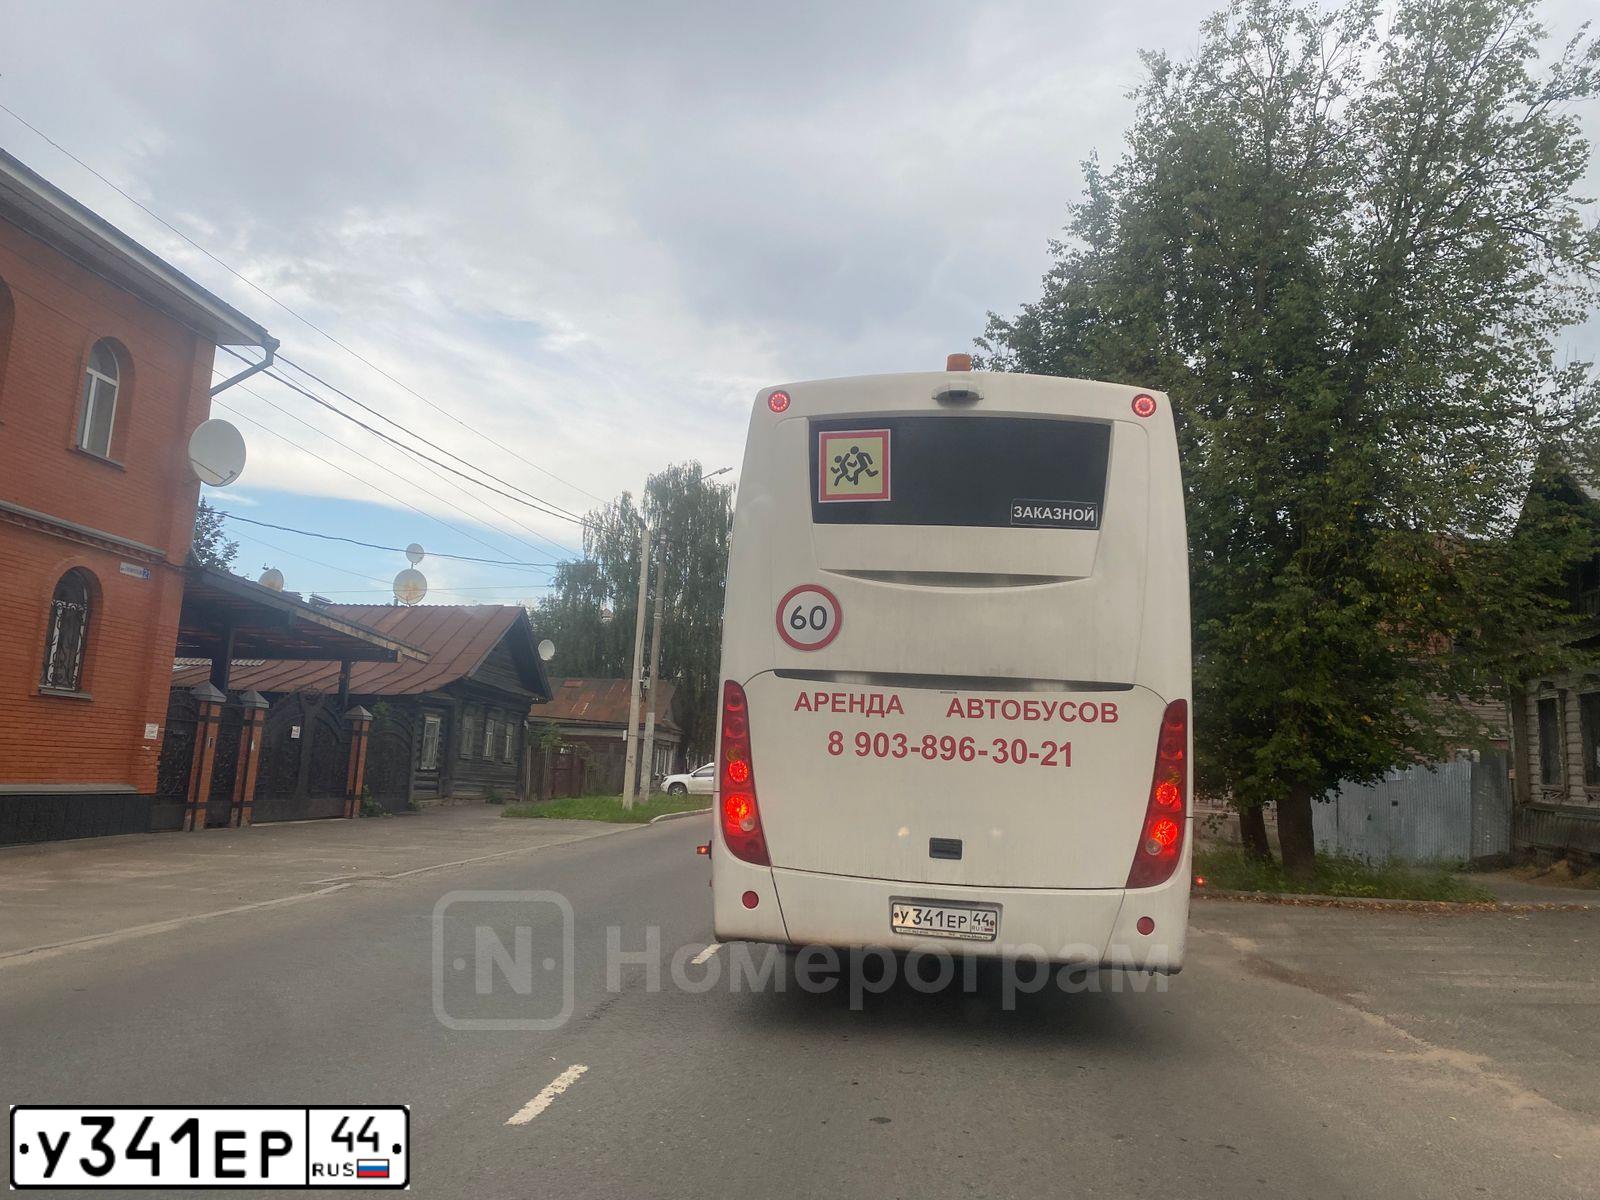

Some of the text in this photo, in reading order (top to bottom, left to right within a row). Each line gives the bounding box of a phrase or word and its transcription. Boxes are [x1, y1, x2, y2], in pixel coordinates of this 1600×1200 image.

[1013, 505, 1095, 522] ЗАКАЗНОЙ
[790, 605, 828, 631] 60
[794, 692, 1119, 724] АРЕНДА АВТОБУСОВ
[827, 730, 1073, 768] 8 903-896-30-21
[973, 913, 990, 926] 44
